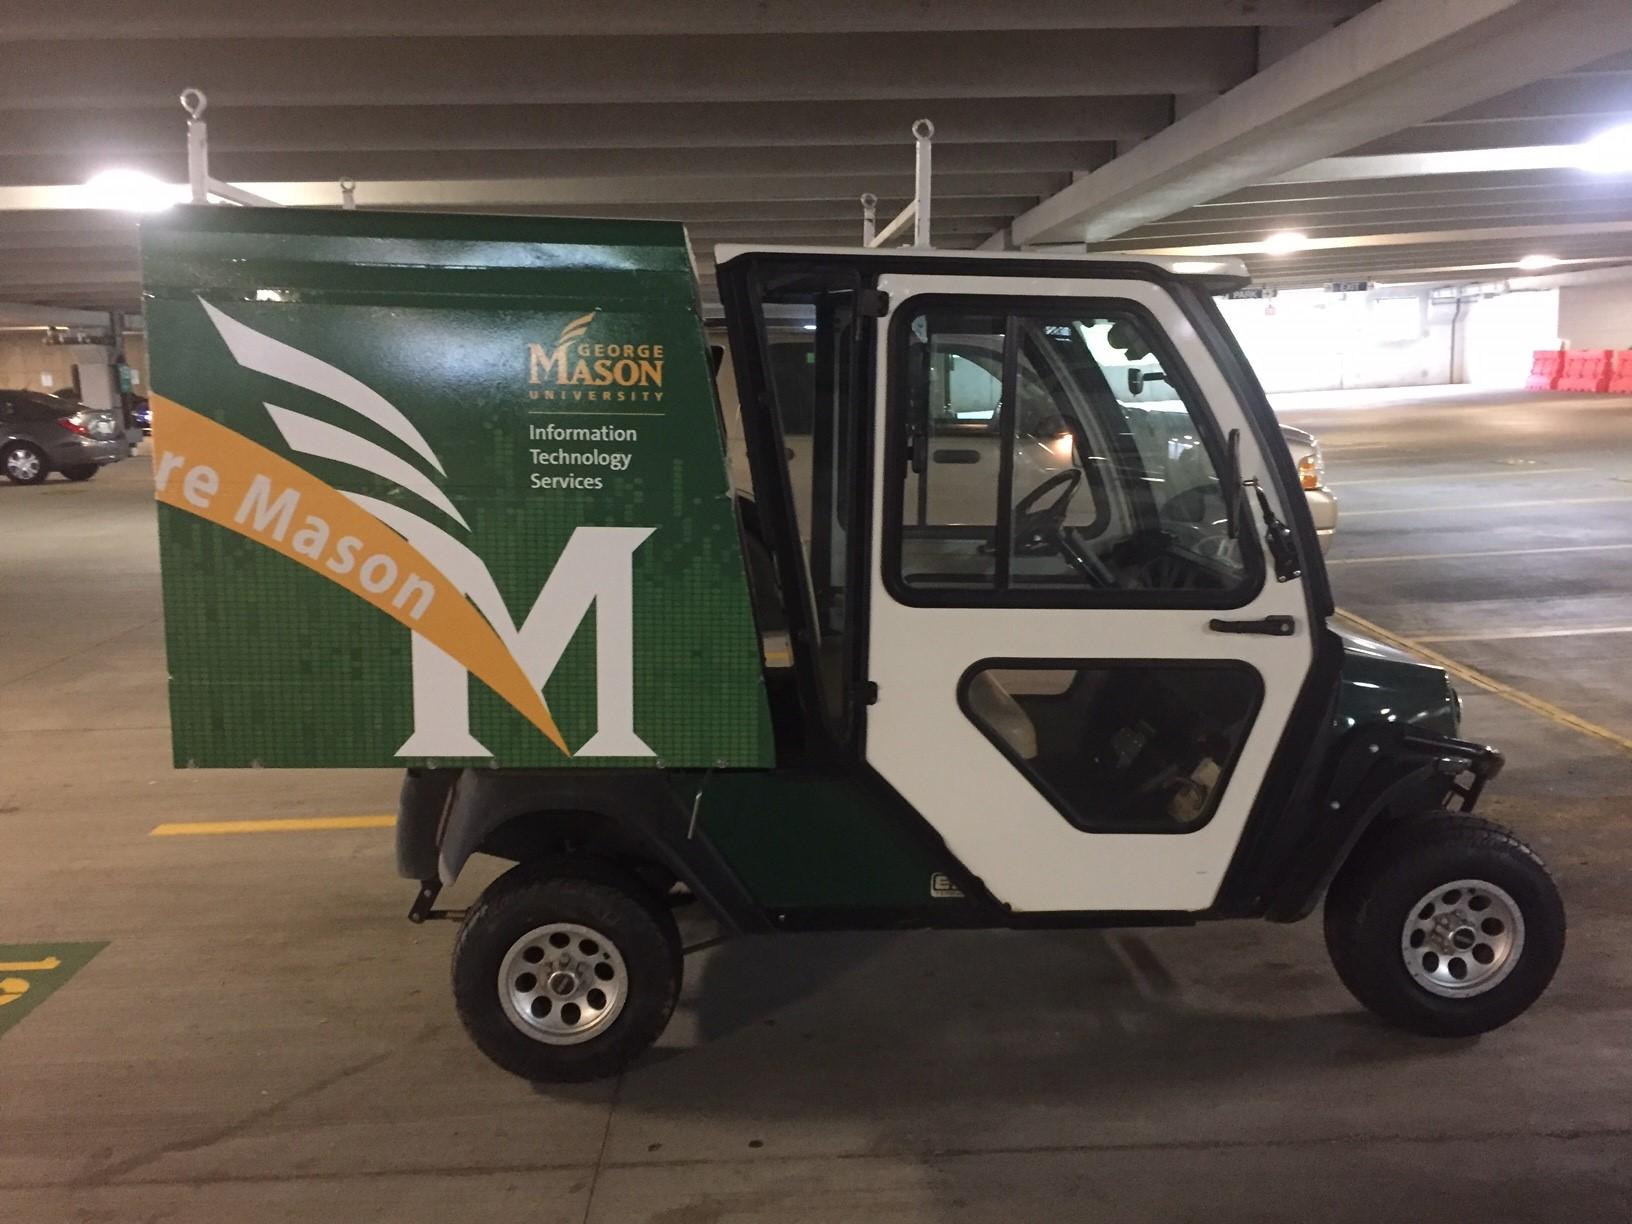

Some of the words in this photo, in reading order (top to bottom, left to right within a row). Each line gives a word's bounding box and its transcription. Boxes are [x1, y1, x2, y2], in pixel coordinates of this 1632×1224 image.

[578, 344, 664, 358] GEORGE
[528, 342, 664, 387] MASON
[529, 390, 664, 402] UNIVERSITY
[529, 424, 638, 442] Information
[529, 449, 633, 471] Technology
[530, 473, 604, 489] Services
[233, 473, 435, 621] Mason
